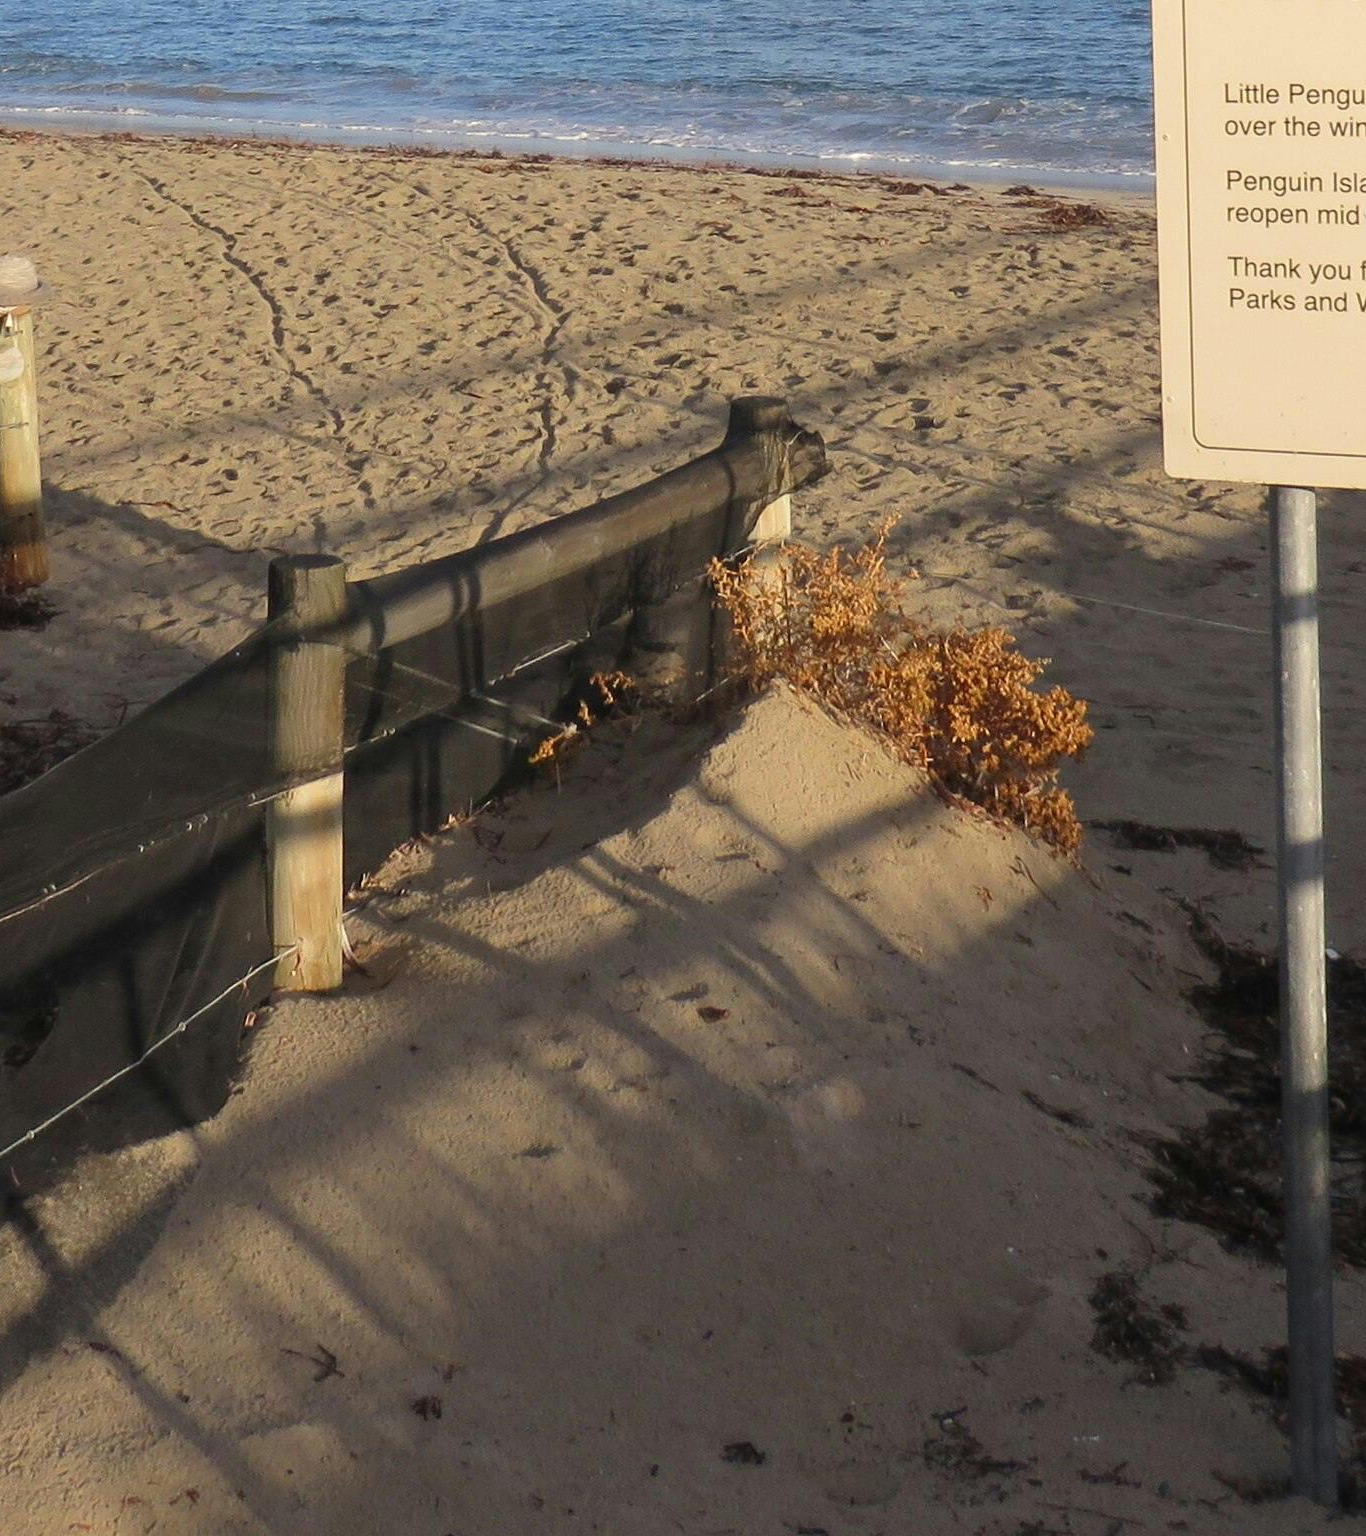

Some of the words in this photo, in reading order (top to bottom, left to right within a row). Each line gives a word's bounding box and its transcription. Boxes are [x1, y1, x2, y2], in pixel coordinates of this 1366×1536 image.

[1224, 82, 1279, 105] Little
[1224, 119, 1276, 137] over
[1283, 115, 1321, 137] the
[1226, 169, 1323, 198] Penguin
[1226, 206, 1309, 229] reopen
[1317, 204, 1360, 226] mid
[1227, 255, 1302, 280] Thank
[1308, 263, 1352, 285] you
[1229, 287, 1296, 311] Parks
[1303, 291, 1348, 313] and
